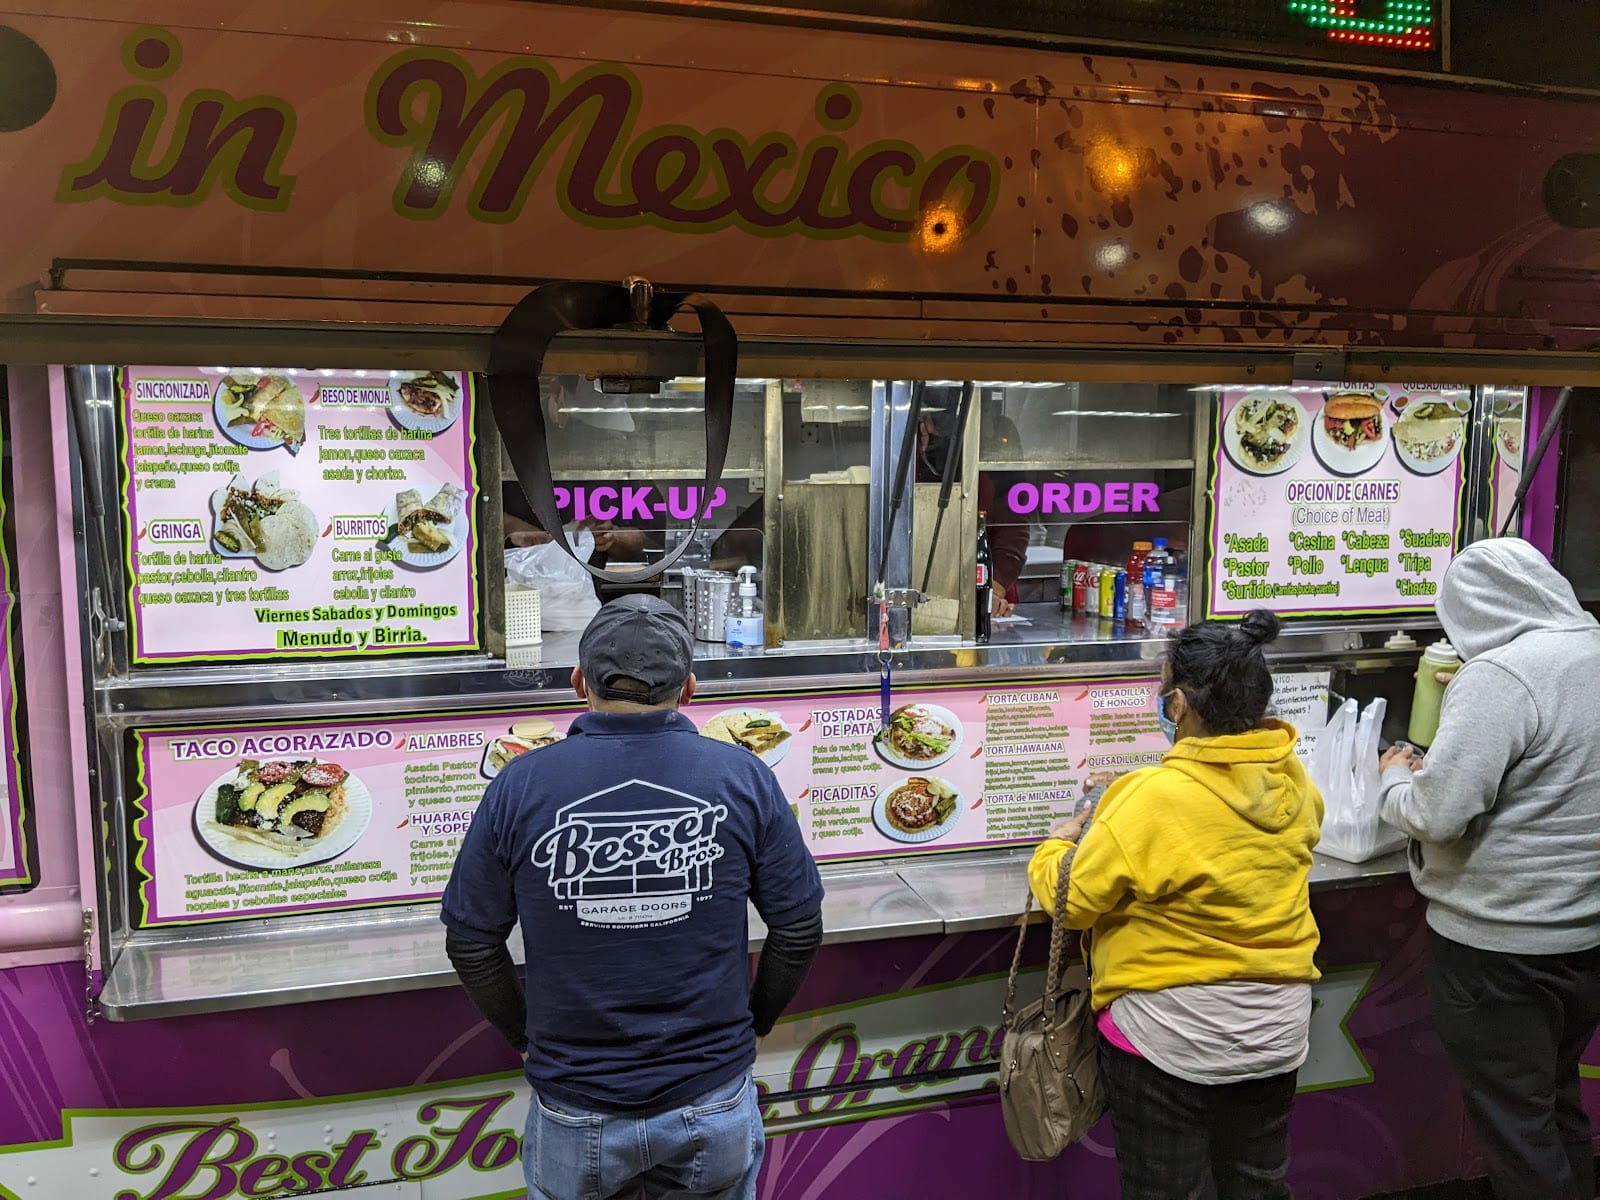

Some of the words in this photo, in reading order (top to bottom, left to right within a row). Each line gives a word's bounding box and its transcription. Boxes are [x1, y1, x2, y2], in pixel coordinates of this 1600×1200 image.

[57, 25, 298, 211] in
[363, 47, 1001, 239] Mexico
[136, 382, 210, 399] SINCRONIZADA
[322, 389, 345, 403] BESO
[347, 390, 358, 403] DE
[360, 390, 391, 404] MONJA
[132, 410, 165, 422] Queso
[167, 412, 203, 422] oaxaca
[133, 426, 165, 439] tortilla
[168, 427, 181, 439] de
[182, 426, 214, 439] harina
[318, 425, 341, 440] Tres
[343, 425, 383, 440] tortillas
[386, 427, 398, 440] de
[400, 427, 433, 440] harina
[319, 445, 387, 464] jamon,queso
[388, 449, 425, 460] oaxaca
[323, 468, 354, 480] asada
[356, 470, 363, 484] y
[136, 479, 142, 491] y
[144, 478, 176, 488] crema
[1288, 483, 1333, 500] OPCION
[1337, 484, 1351, 500] DE
[1354, 483, 1398, 500] CARNES
[1007, 482, 1160, 514] ORDER
[1293, 507, 1338, 528] (Choice
[1342, 507, 1353, 523] of
[1358, 507, 1390, 527] Meat)
[151, 523, 200, 539] GRINGA
[336, 520, 386, 535] BURRITOS
[136, 551, 172, 565] Tortilla
[174, 551, 187, 565] de
[189, 550, 222, 565] harina
[332, 548, 361, 562] Carne
[363, 548, 373, 561] al
[375, 549, 403, 564] gusto
[138, 592, 172, 608] queso
[175, 592, 213, 604] oaxaca
[215, 592, 223, 606] y
[225, 588, 246, 601] tres
[250, 587, 289, 601] tortillas
[333, 586, 369, 600] cebolla
[371, 588, 378, 602] y
[380, 585, 416, 600] cilantro
[255, 608, 309, 623] Viernes
[312, 605, 372, 621] Sabados
[375, 608, 383, 621] y
[387, 604, 457, 618] Domingos
[283, 629, 352, 647] Menudo
[359, 631, 368, 647] y
[375, 626, 427, 643] Birria.
[988, 694, 1018, 703] TORTA
[1020, 692, 1059, 702] CUBANA
[1091, 688, 1151, 698] QUESADILLAS
[1107, 698, 1145, 708] HONGOS
[814, 709, 882, 723] TOSTADAS
[823, 725, 839, 736] DE
[844, 723, 874, 735] PATA
[172, 740, 236, 757] TACO
[242, 731, 392, 753] ACORAZADO
[409, 733, 483, 749] ALAMBRES
[987, 745, 1014, 755] TORTA
[1016, 742, 1063, 753] HAWAIANA
[405, 763, 439, 773] Asada
[442, 761, 478, 771] Pastor
[1088, 755, 1139, 767] QUESADILLA
[405, 783, 487, 797] pimiento,morro
[811, 785, 876, 802] PICADITAS
[987, 794, 1014, 803] TORTA
[1016, 794, 1027, 802] de
[1028, 790, 1072, 801] MILANEZA
[408, 800, 415, 808] y
[418, 796, 452, 807] queso
[423, 826, 430, 835] Y
[435, 823, 469, 834] SOPE
[410, 840, 444, 850] Carne
[447, 837, 457, 846] al
[531, 804, 729, 887] Besser
[656, 843, 725, 875] Bros.
[185, 872, 222, 885] Tortilla
[226, 869, 259, 882] hecha
[369, 871, 397, 883] cotija
[411, 877, 417, 886] y
[421, 874, 450, 884] ques
[186, 900, 229, 912] nopales
[233, 900, 239, 910] y
[243, 894, 288, 907] cebollas
[291, 889, 347, 902] especiales
[581, 905, 637, 914] GARAGE
[641, 901, 688, 911] DOORS
[650, 914, 690, 928] CALIFORNIA
[113, 1117, 381, 1200] Best
[391, 1091, 524, 1181] Fo
[788, 1022, 1001, 1113] Oran
